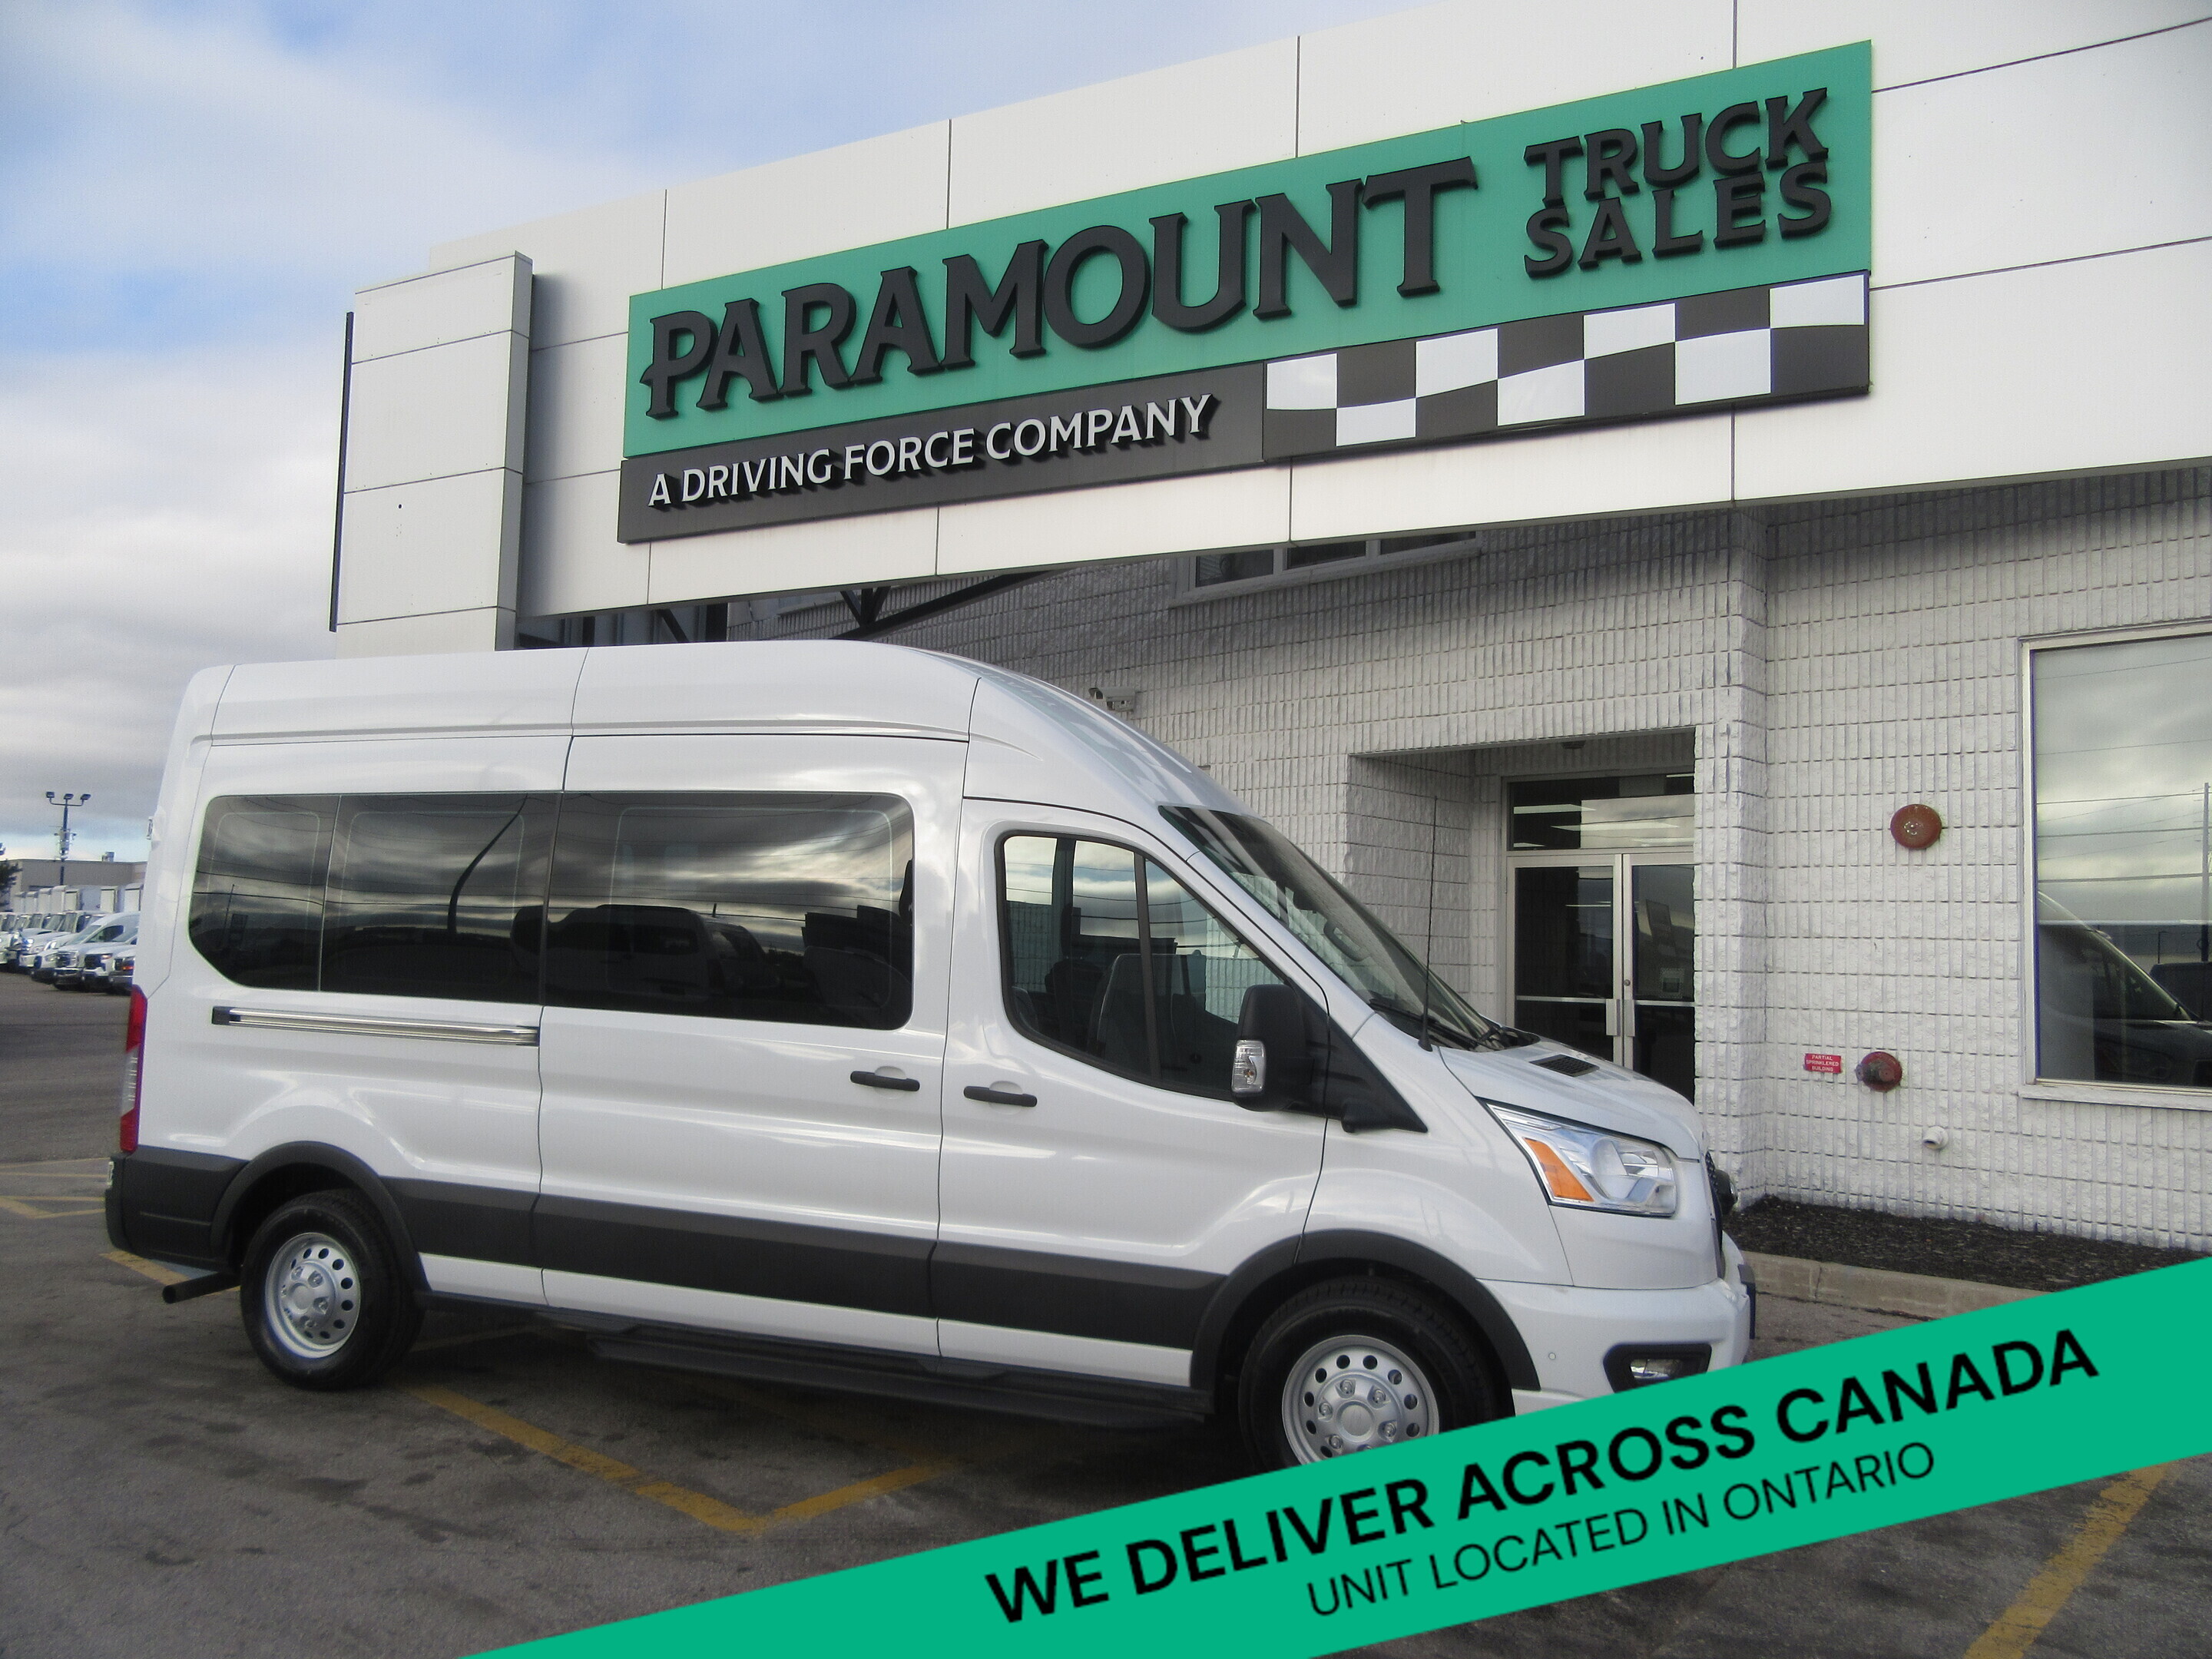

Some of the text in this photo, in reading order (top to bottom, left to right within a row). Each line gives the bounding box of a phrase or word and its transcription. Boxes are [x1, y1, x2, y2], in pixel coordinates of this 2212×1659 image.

[1523, 87, 1832, 210] TRUCK
[1523, 160, 1833, 279] SALES
[639, 155, 1479, 421] PARAMOUNT
[647, 392, 1214, 508] A DRIVING FORCE COMPANY
